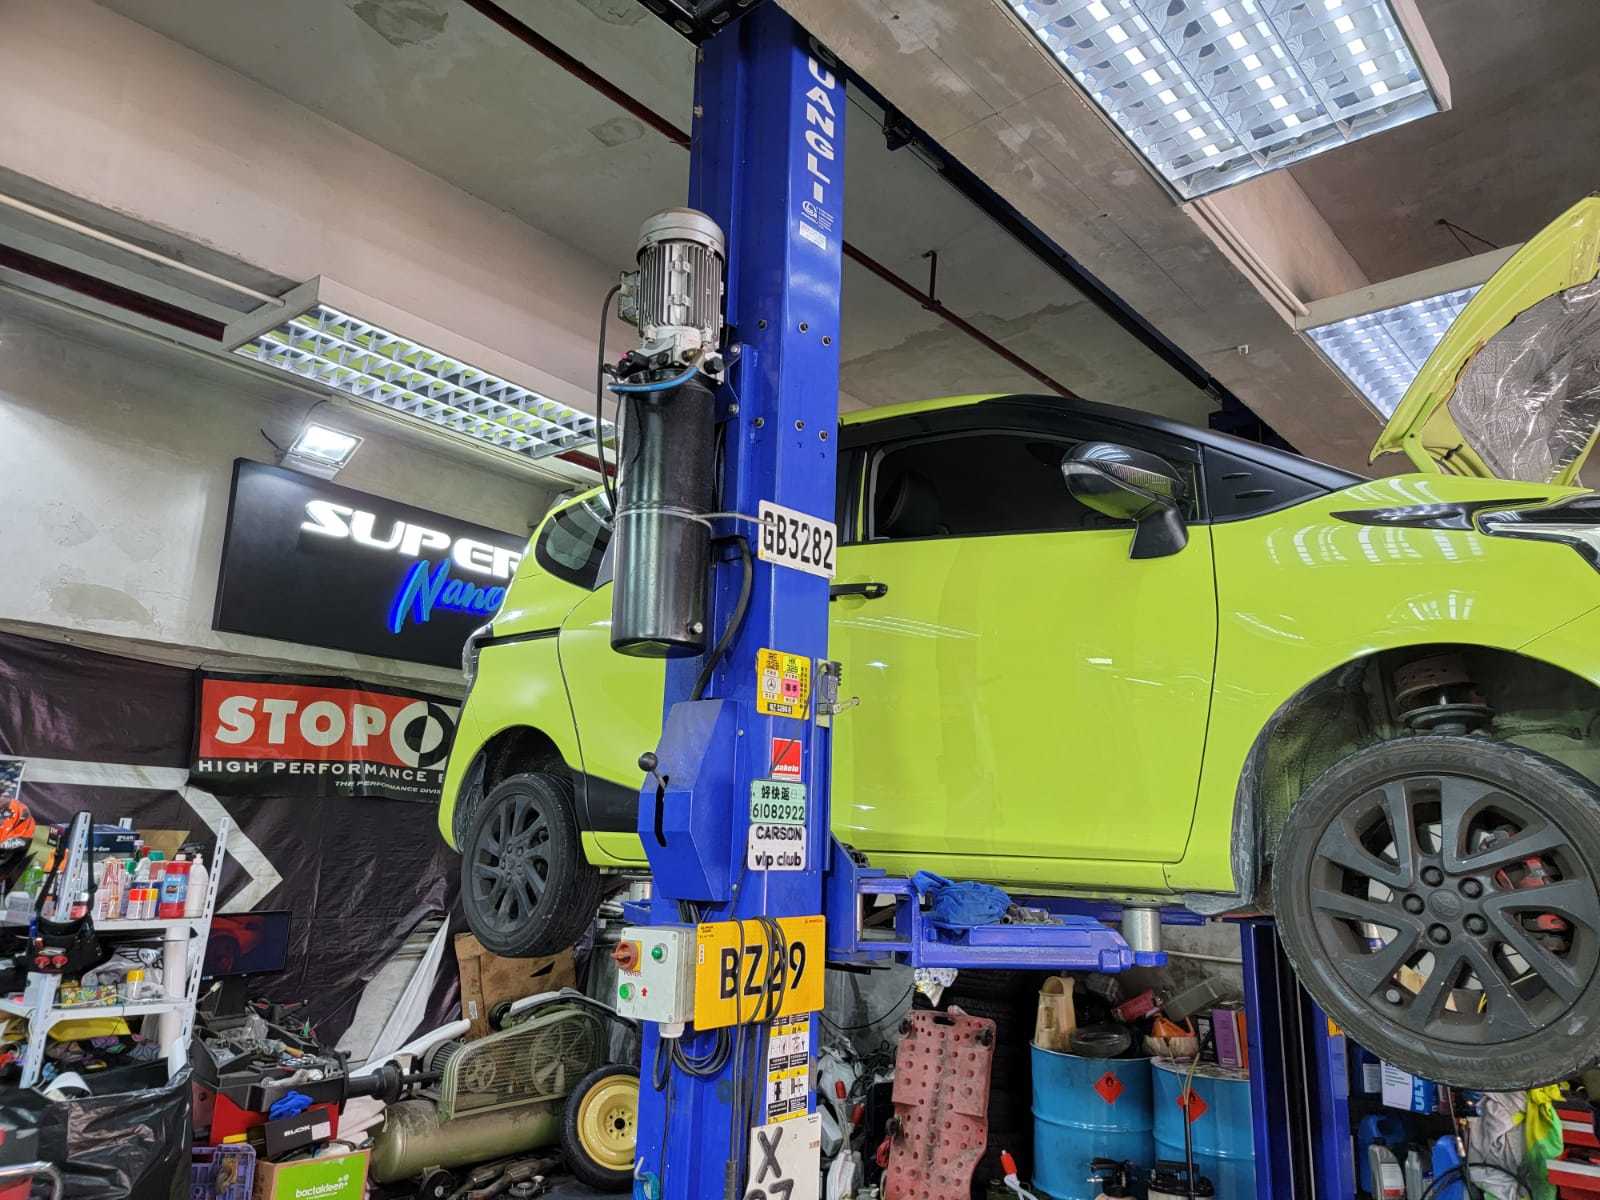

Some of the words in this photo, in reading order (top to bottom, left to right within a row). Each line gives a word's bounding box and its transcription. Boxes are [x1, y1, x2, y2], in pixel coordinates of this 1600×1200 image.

[763, 510, 833, 570] GB3282
[199, 760, 258, 774] HIGH
[274, 762, 427, 783] PERFORMANCE
[357, 780, 418, 793] PERFORMANCE
[752, 803, 805, 821] 61082922
[755, 825, 803, 841] CARSON
[755, 852, 774, 870] vip
[776, 851, 802, 867] club
[758, 1126, 784, 1184] X
